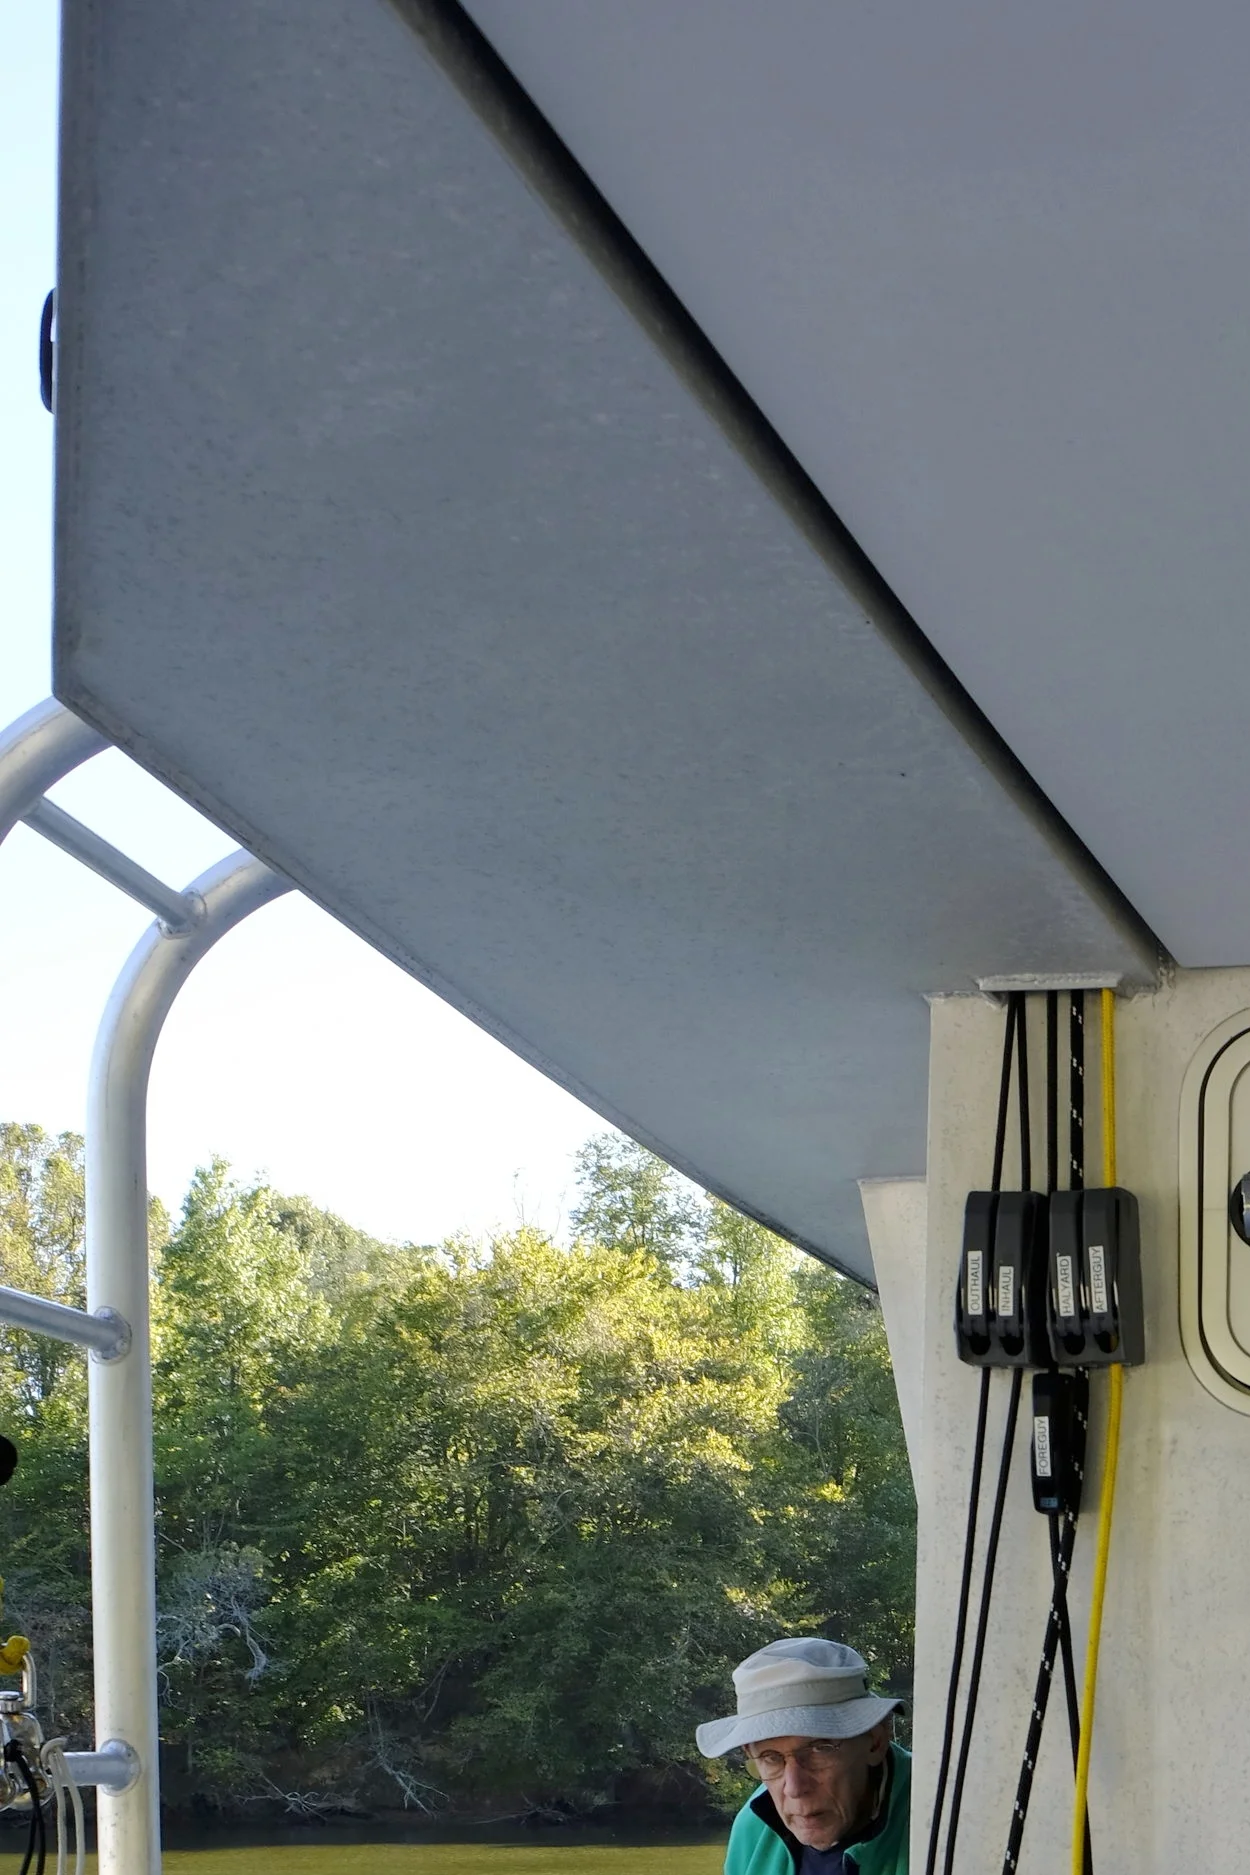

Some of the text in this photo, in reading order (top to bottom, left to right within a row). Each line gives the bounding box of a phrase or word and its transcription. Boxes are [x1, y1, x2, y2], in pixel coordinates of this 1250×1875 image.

[970, 1255, 981, 1312] OUTHAUL
[1001, 1267, 1012, 1312] INHAUL
[1059, 1257, 1073, 1315] HALYARD
[1092, 1247, 1105, 1312] AFTERGUY
[1036, 1417, 1049, 1475] FOREGUY
